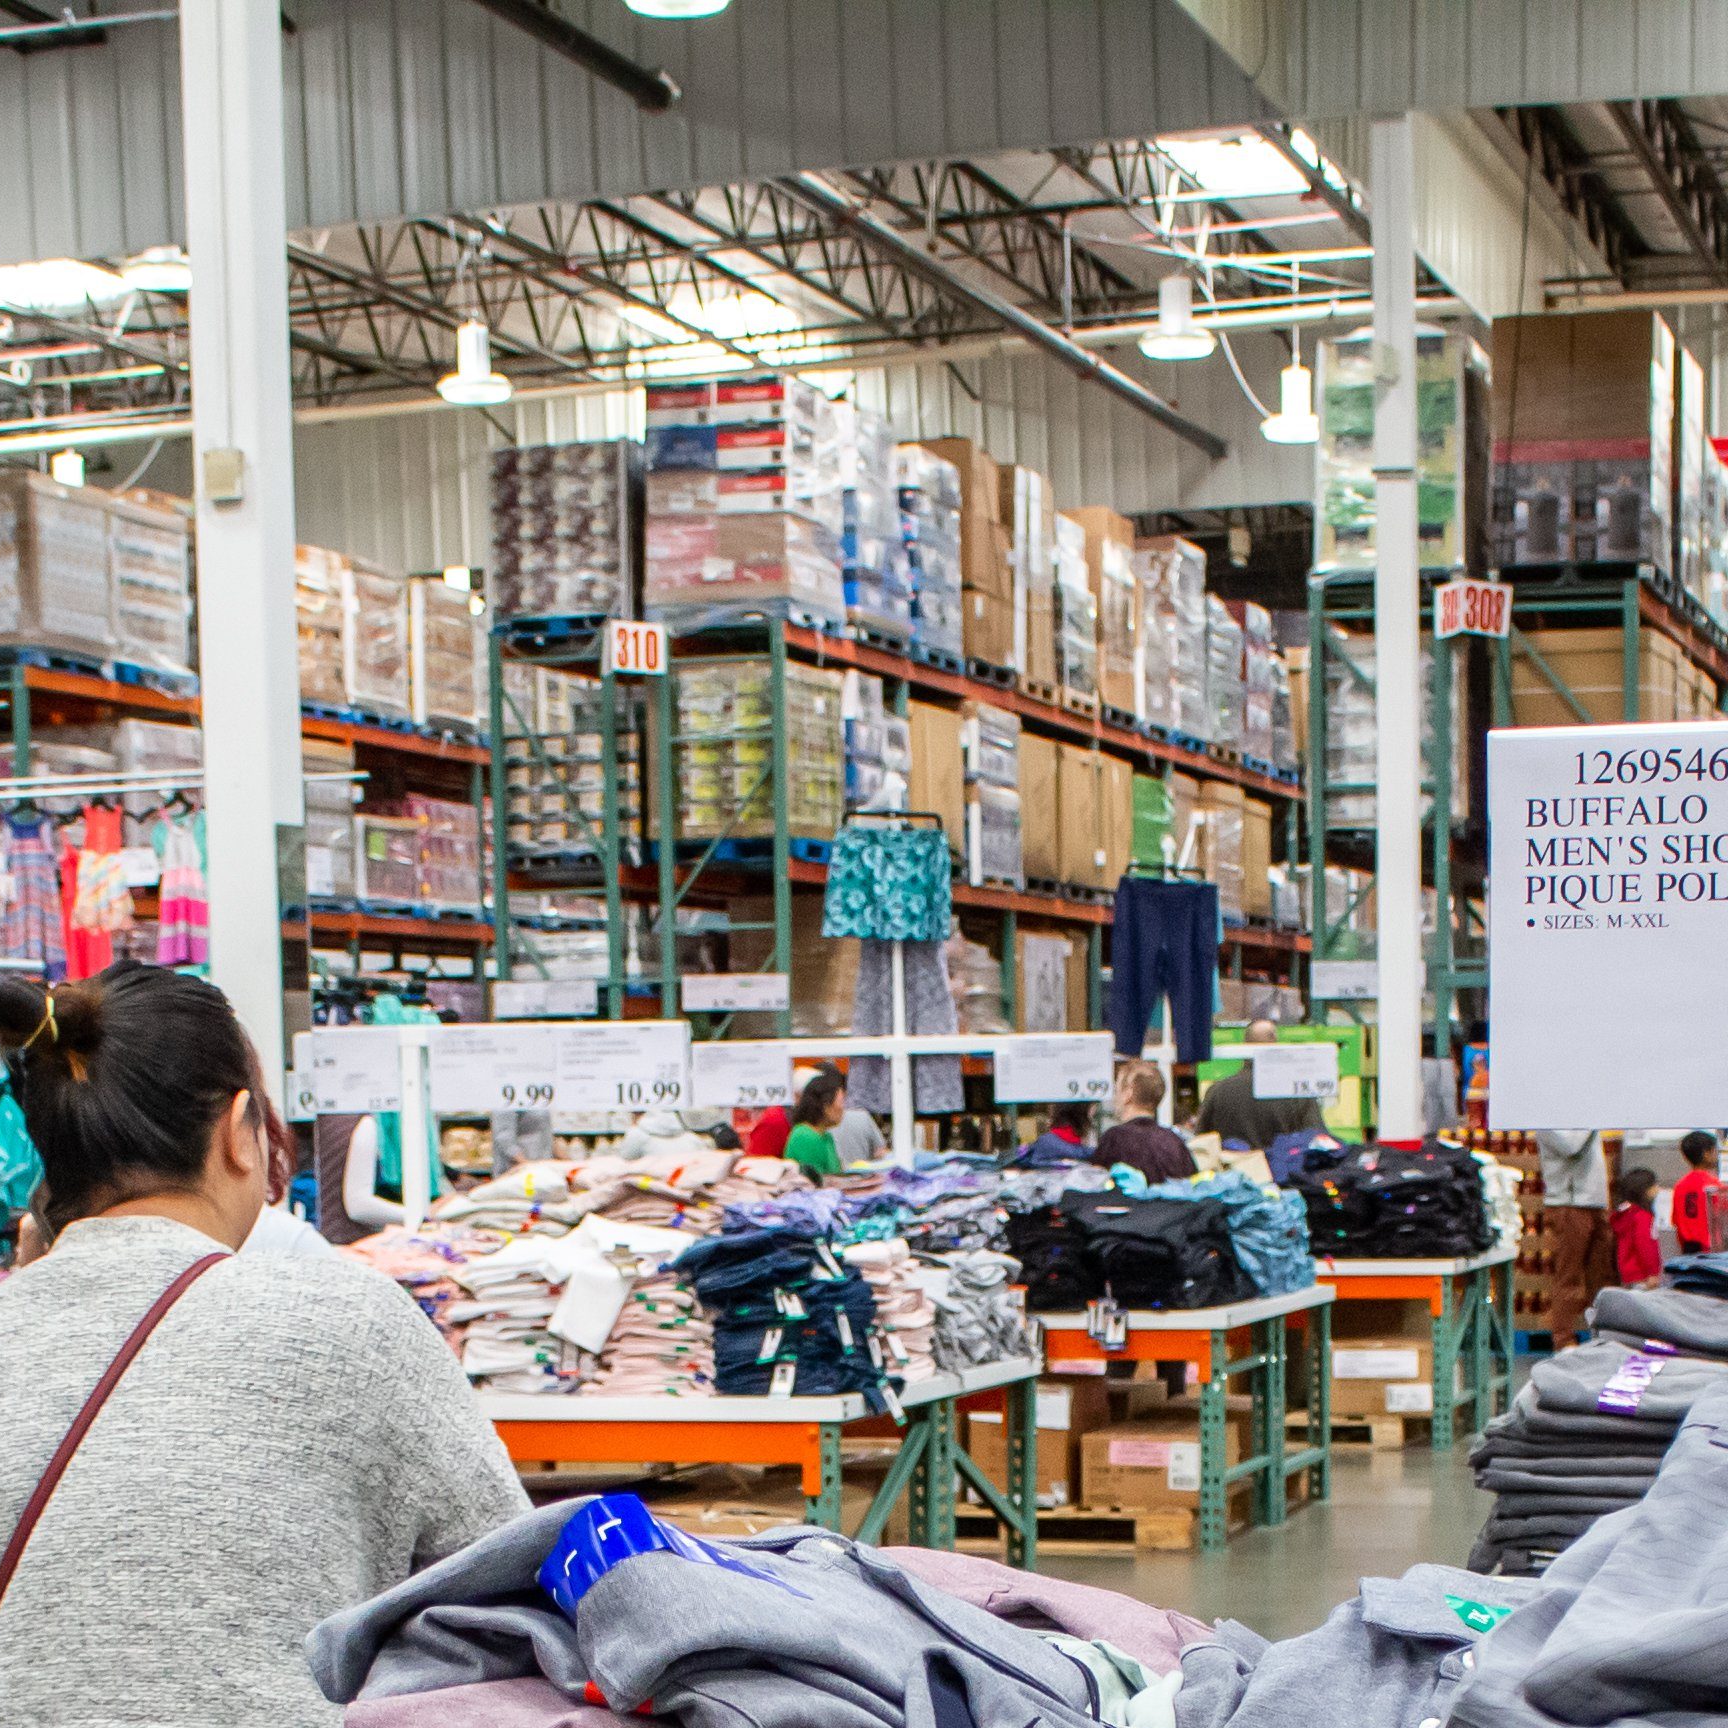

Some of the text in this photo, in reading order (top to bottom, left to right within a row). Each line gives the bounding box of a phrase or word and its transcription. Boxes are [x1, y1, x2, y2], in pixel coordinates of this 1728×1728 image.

[617, 627, 658, 670] 310
[1525, 794, 1708, 828] BUFFALO
[1525, 835, 1648, 867] MEN'S
[1525, 873, 1643, 911] PIQUE
[1544, 913, 1670, 930] SIZES: M-XXL
[501, 1084, 555, 1107] 9.99
[615, 1081, 682, 1105] 10.99
